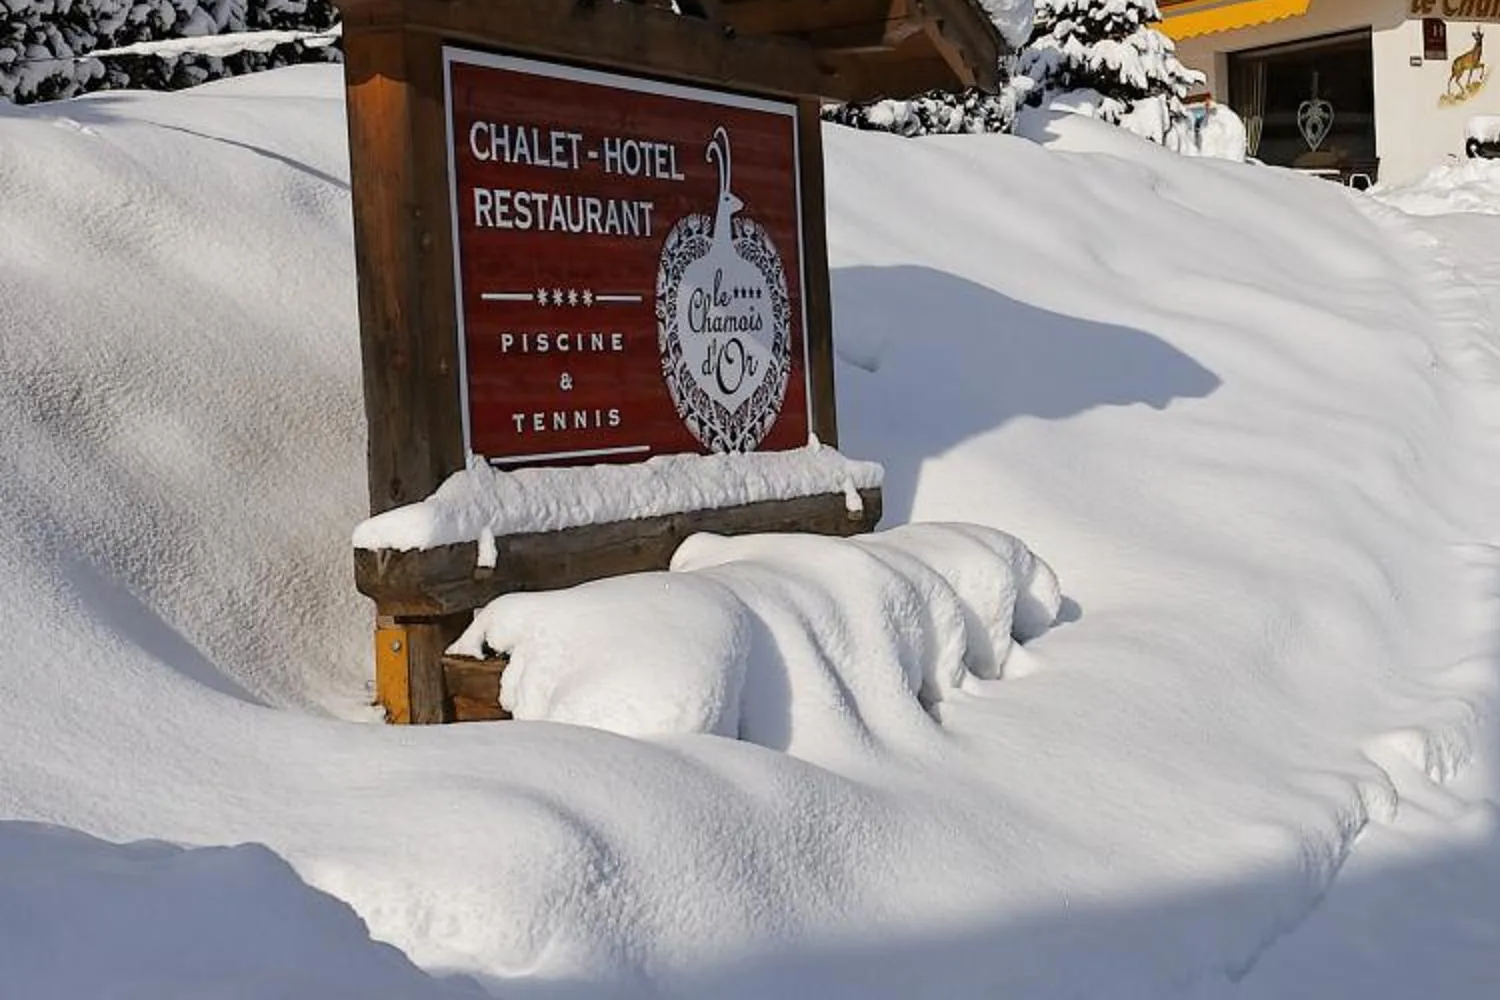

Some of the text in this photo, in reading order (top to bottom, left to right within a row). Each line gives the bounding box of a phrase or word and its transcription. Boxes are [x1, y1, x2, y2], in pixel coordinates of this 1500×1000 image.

[473, 187, 653, 237] RESTAURANT
[713, 267, 732, 307] le
[688, 287, 763, 334] Chamois
[501, 333, 623, 352] PISCINE
[559, 372, 573, 391] &
[701, 338, 758, 394] d'Or
[512, 409, 621, 433] TENNIS
